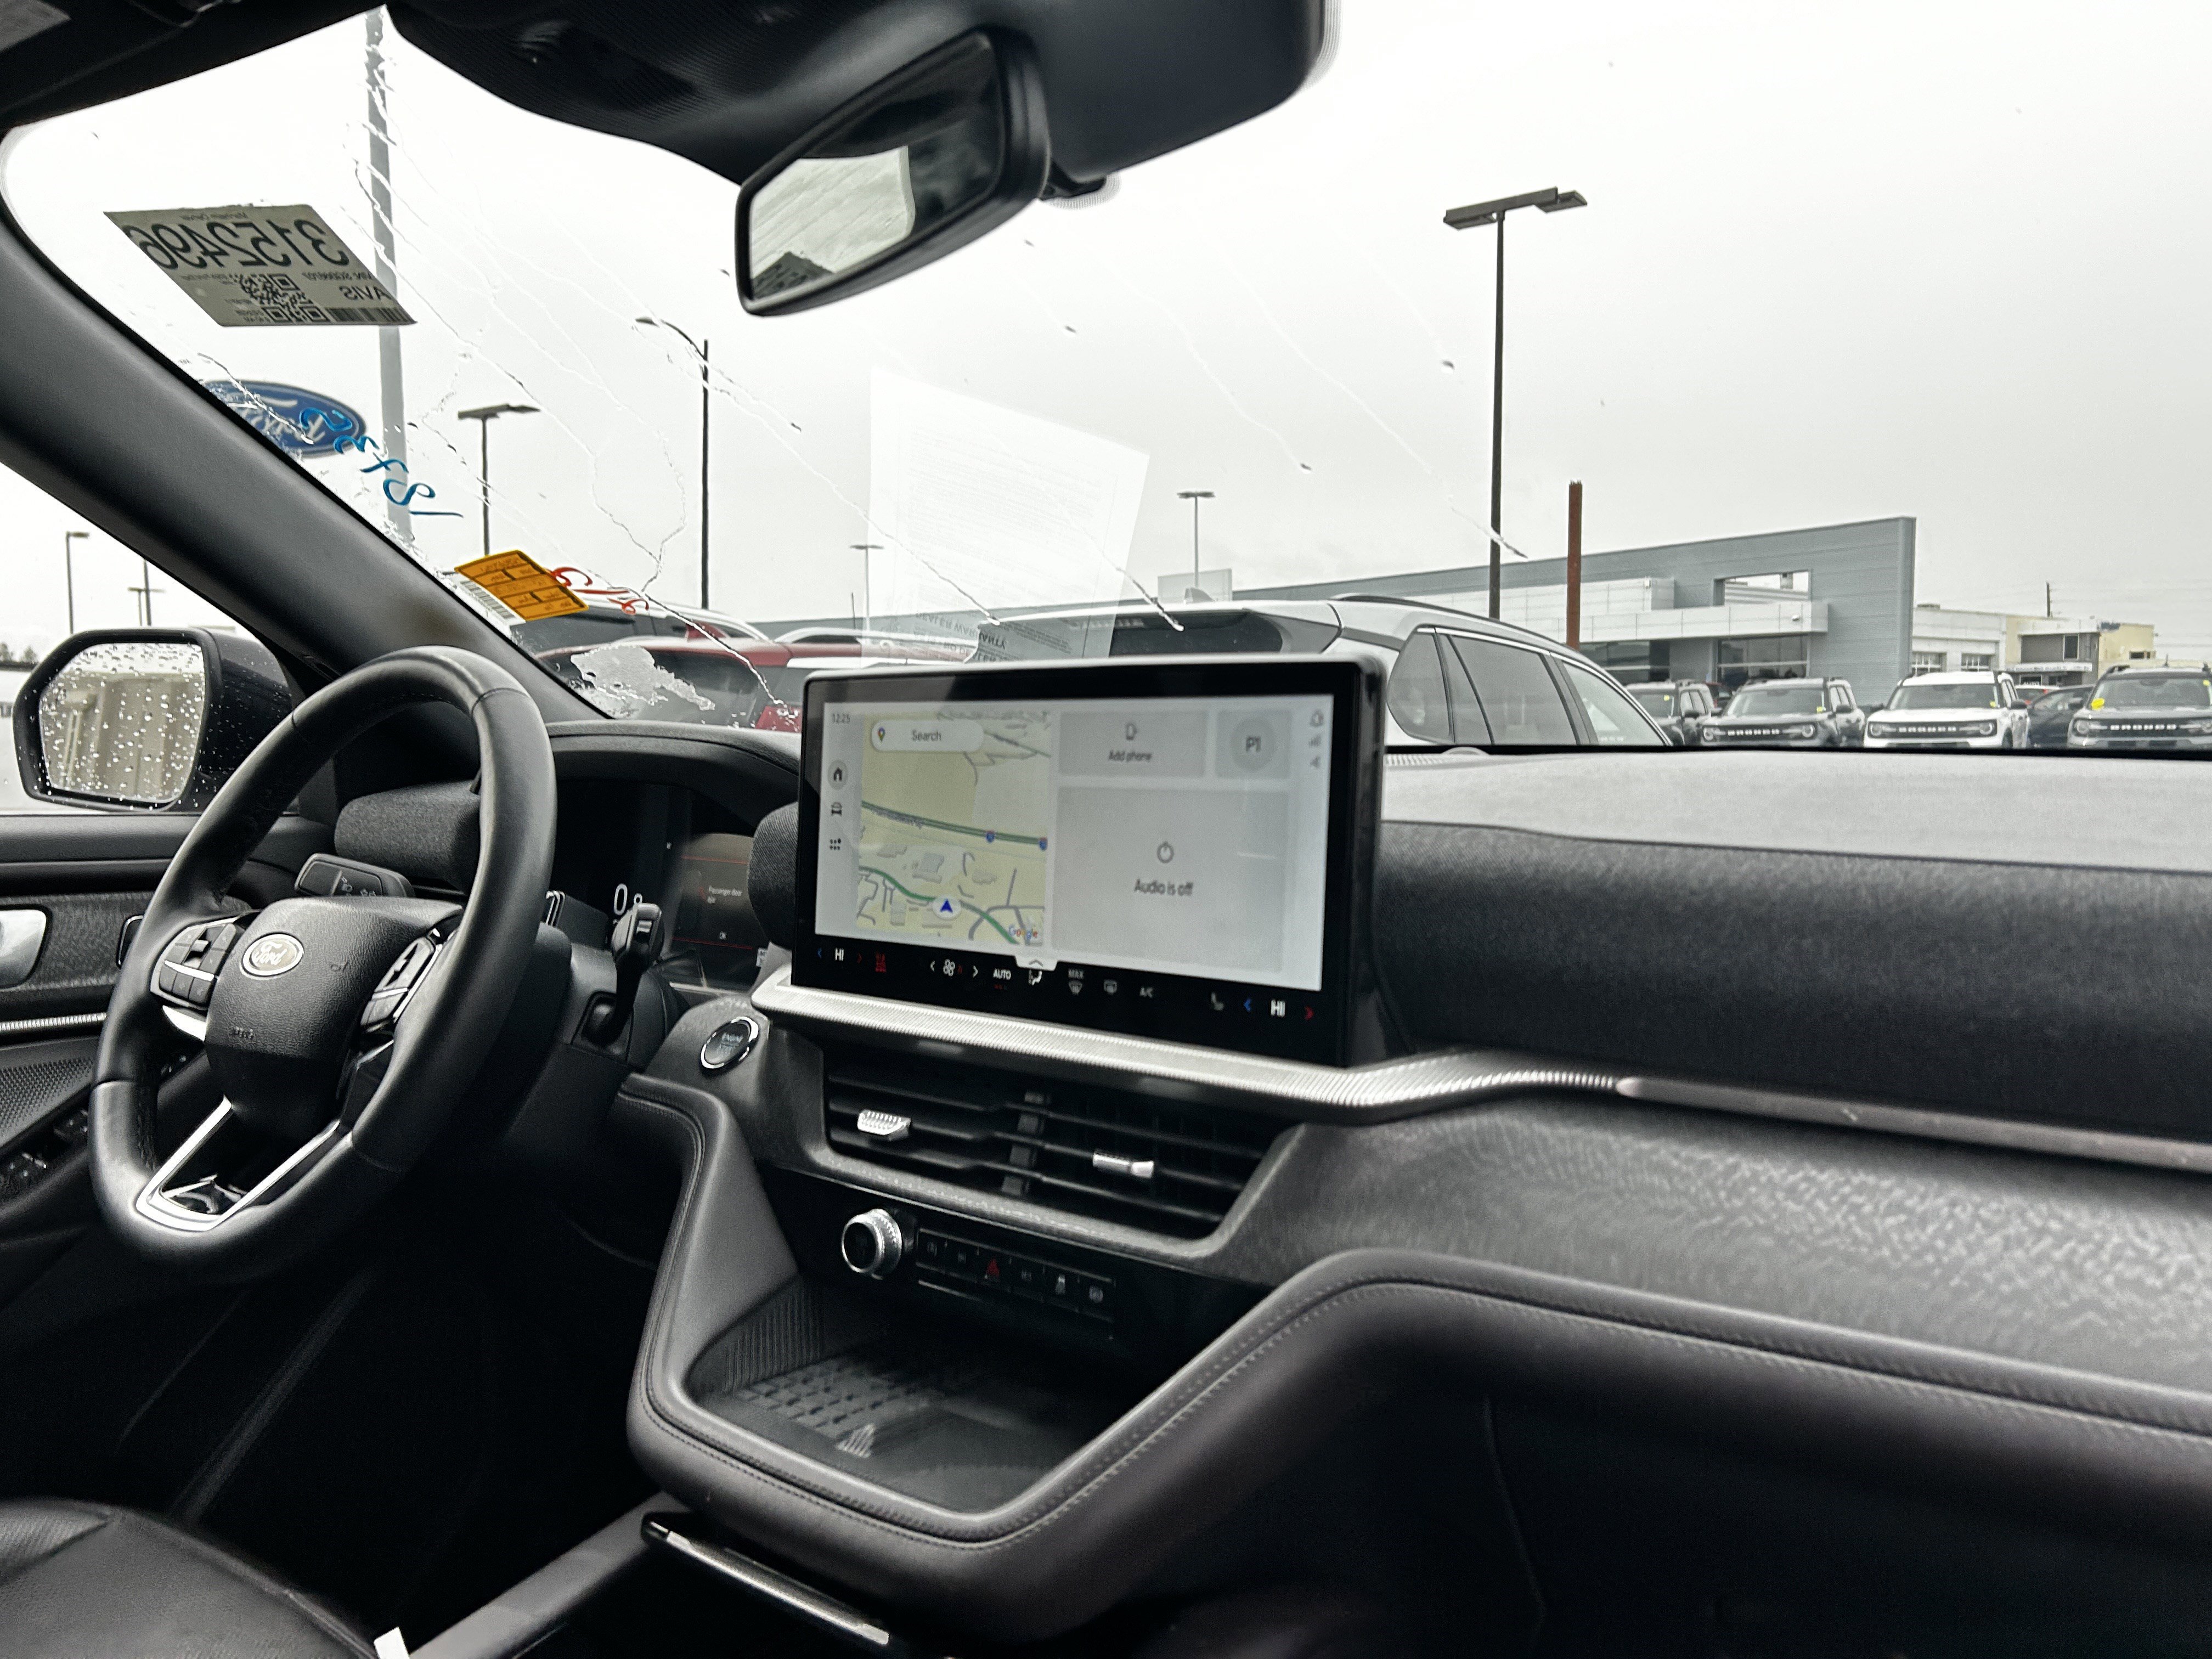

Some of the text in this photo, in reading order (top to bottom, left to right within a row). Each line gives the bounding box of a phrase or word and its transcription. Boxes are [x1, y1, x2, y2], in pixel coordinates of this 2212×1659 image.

[912, 729, 941, 741] Search
[1109, 749, 1152, 763] Add phone
[1133, 878, 1193, 896] Audio is off
[253, 941, 287, 965] Ford
[834, 947, 844, 961] HI
[993, 968, 1012, 980] AUTO
[1068, 969, 1084, 979] MAX
